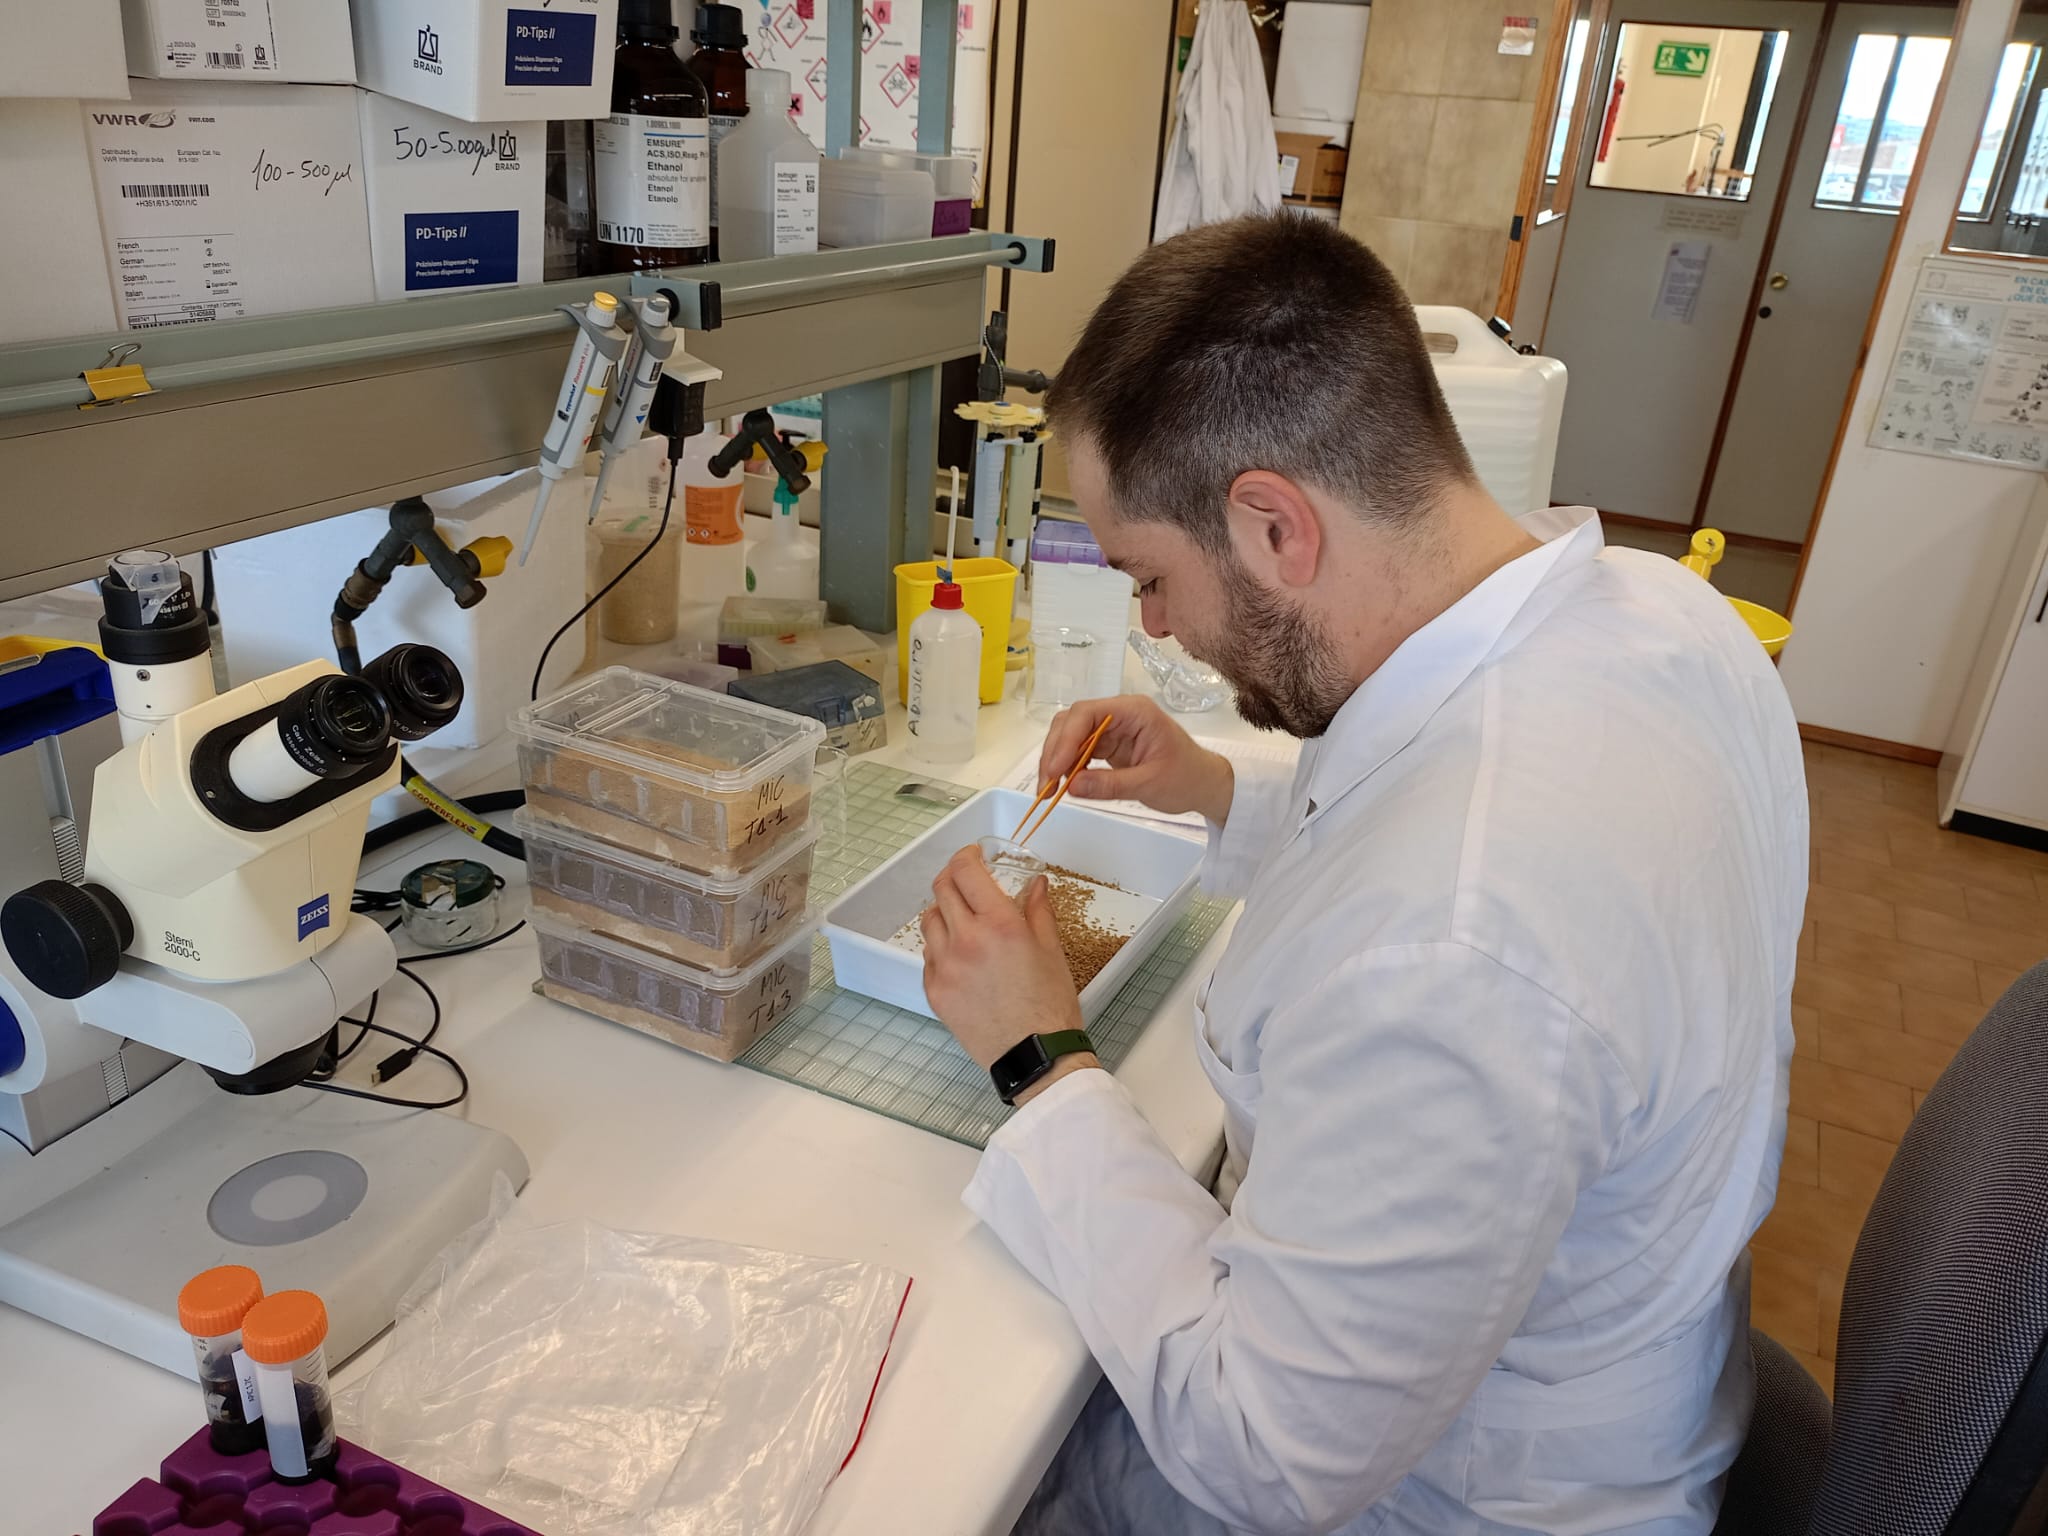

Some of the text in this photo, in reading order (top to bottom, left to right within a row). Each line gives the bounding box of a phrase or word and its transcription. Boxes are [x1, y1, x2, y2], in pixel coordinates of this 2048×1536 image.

[516, 25, 548, 42] PD-Tips
[413, 58, 443, 76] BRAND
[92, 113, 138, 126] VWR
[188, 116, 216, 124] vwr.com
[101, 148, 131, 156] Distributed
[177, 149, 201, 157] European
[495, 162, 521, 172] BRAND
[647, 161, 684, 172] Ethanol
[647, 184, 674, 193] Etanol
[647, 194, 679, 204] Etanolo
[415, 227, 458, 241] PD-Tips
[600, 222, 612, 241] UN
[615, 225, 645, 244] 1170
[117, 242, 140, 250] French
[122, 274, 148, 282] Spanish
[125, 289, 143, 297] Italian
[292, 724, 326, 765] Carl Zeiss
[411, 788, 469, 831] COOKERFLEX
[301, 903, 329, 926] ZEISS
[164, 930, 195, 950] Stemi
[164, 940, 201, 963] 2000-C
[760, 963, 787, 998] MIC
